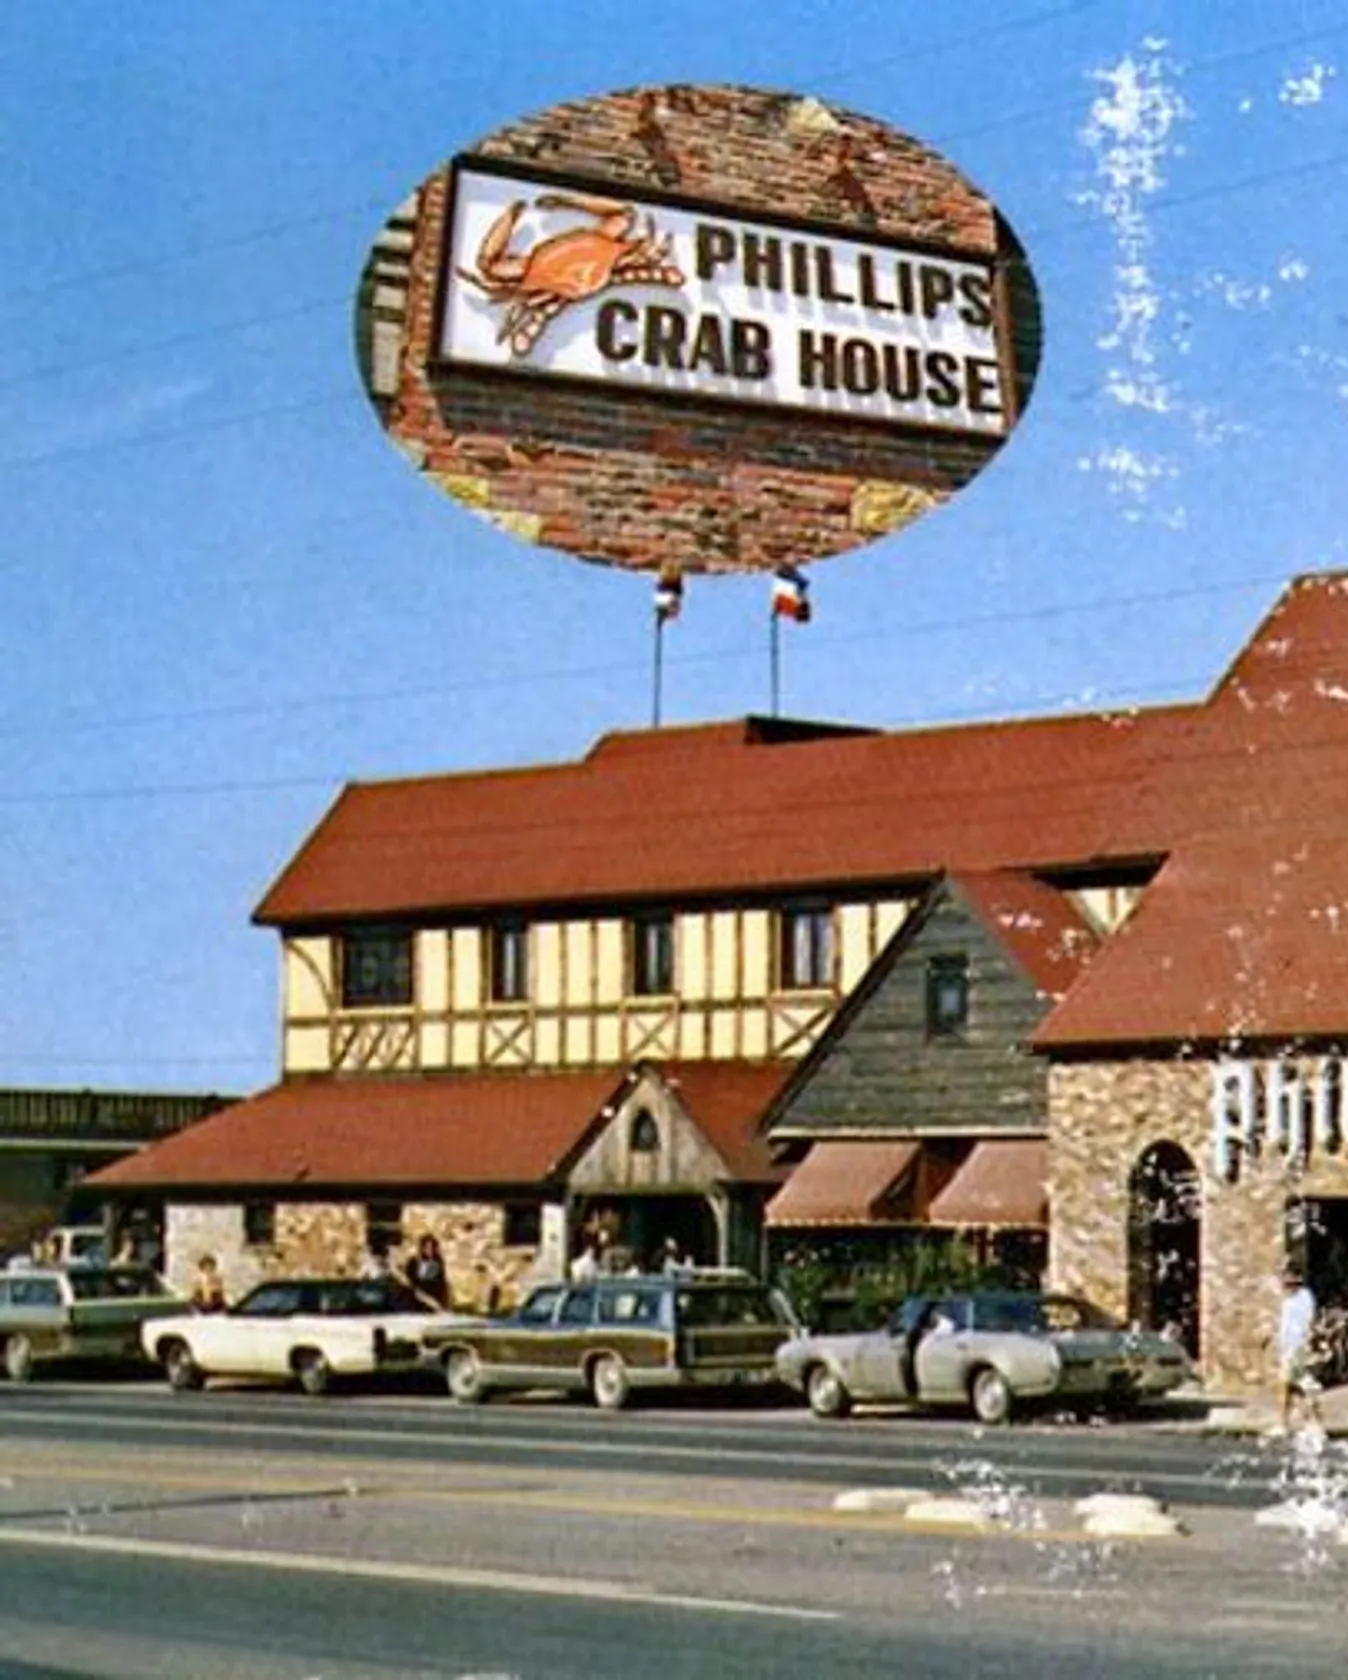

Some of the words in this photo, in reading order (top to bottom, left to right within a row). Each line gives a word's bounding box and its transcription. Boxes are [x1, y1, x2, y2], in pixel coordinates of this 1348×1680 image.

[695, 222, 994, 330] PHILLIPS
[595, 300, 772, 382] CRAB
[799, 328, 1000, 414] HOUSE
